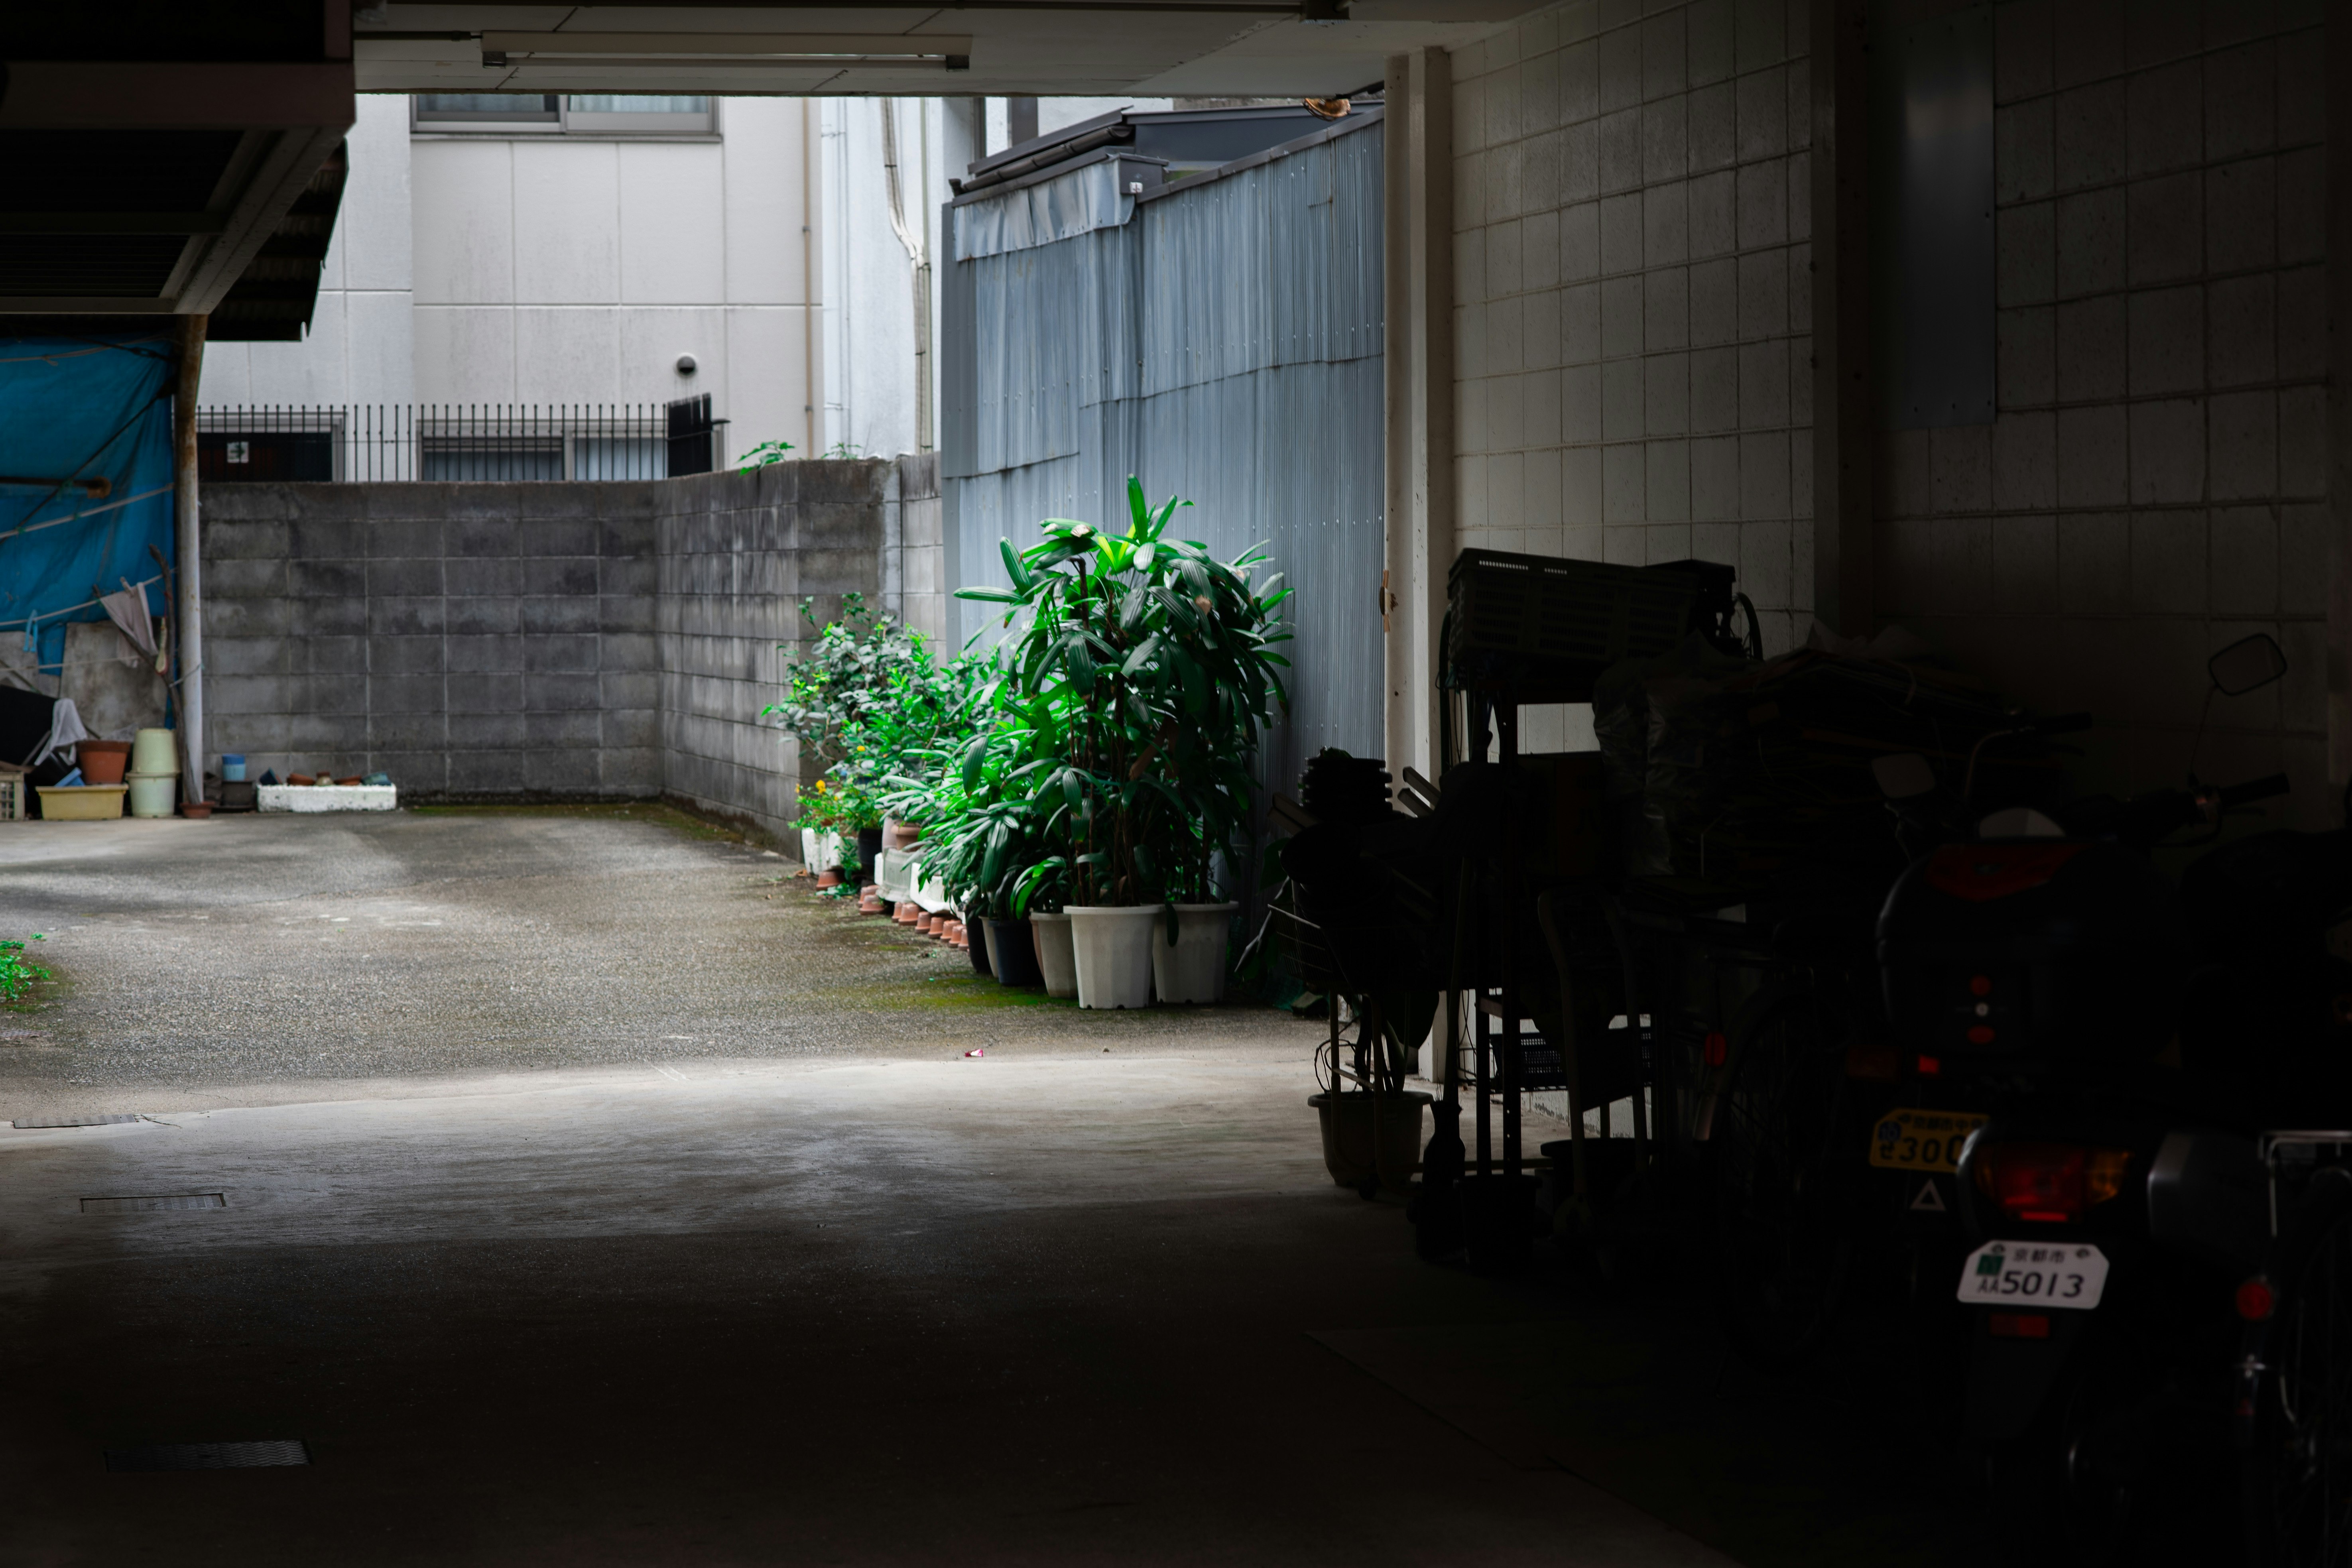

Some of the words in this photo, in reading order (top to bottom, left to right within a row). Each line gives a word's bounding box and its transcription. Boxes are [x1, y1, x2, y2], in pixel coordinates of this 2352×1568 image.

[2013, 1248, 2065, 1263] 京都市
[2001, 1271, 2084, 1298] 5013
